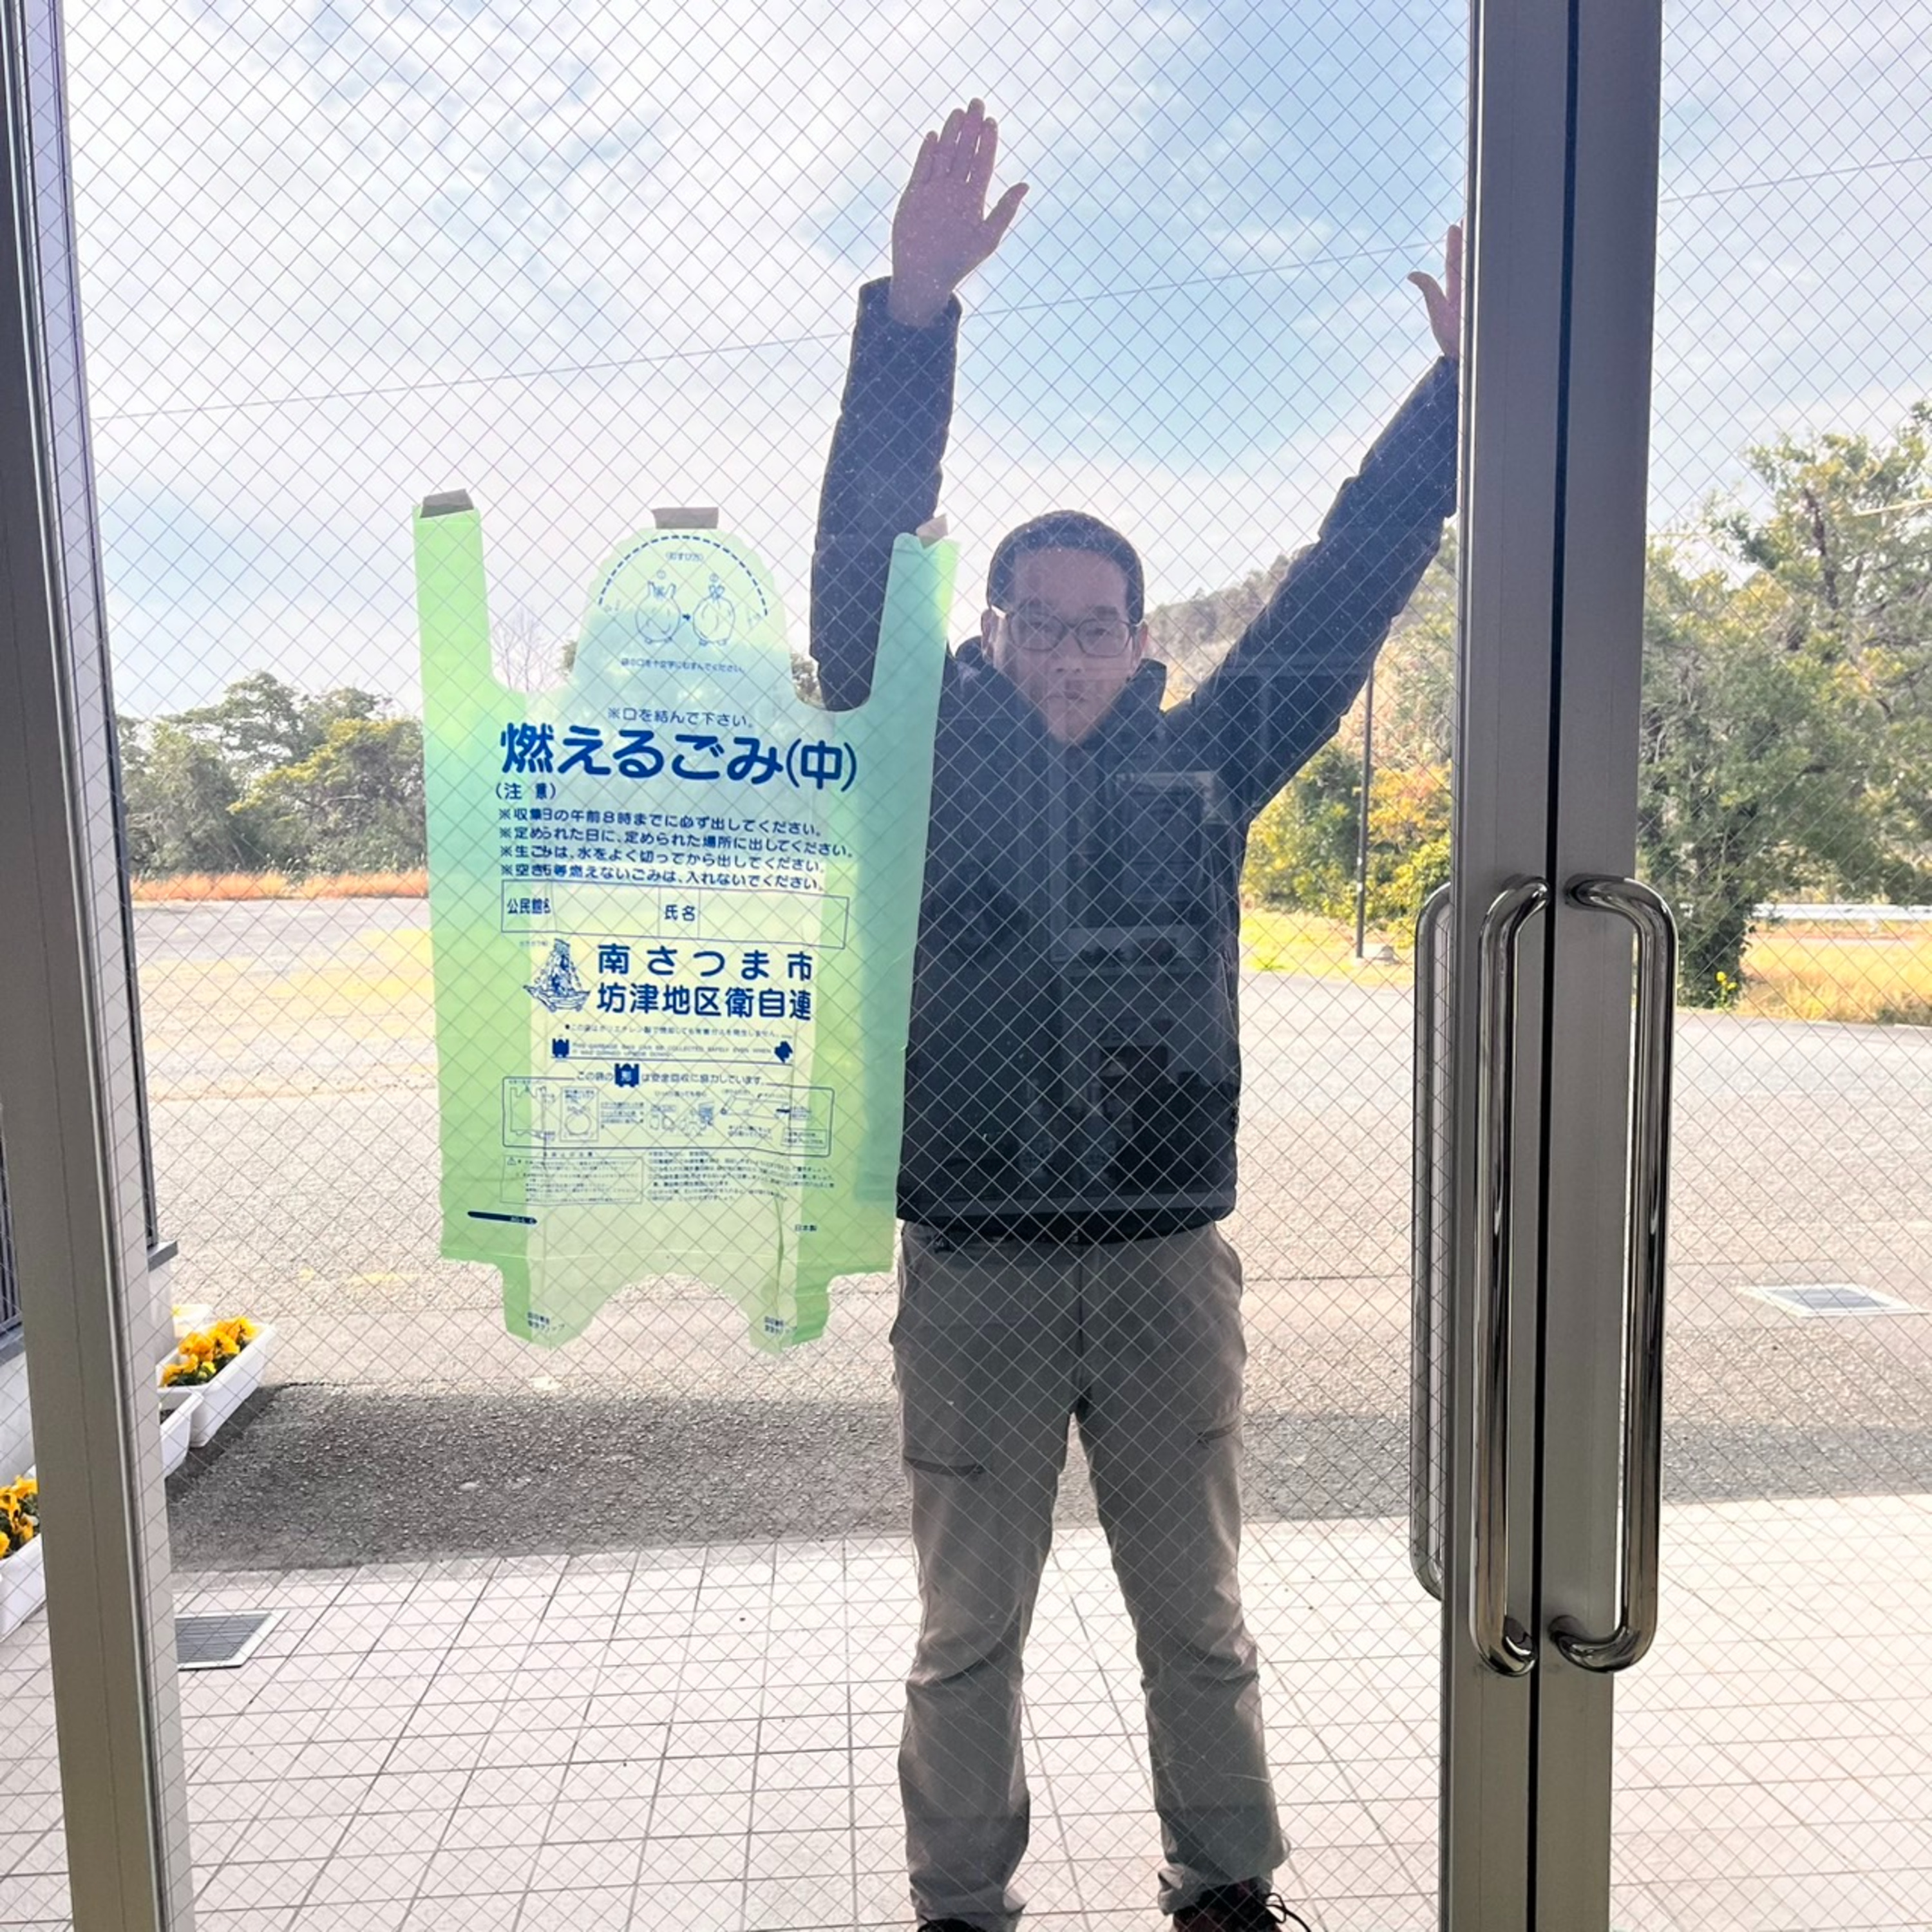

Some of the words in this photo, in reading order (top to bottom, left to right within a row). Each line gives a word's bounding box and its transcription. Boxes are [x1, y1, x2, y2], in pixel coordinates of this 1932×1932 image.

[608, 707, 753, 728] ※口を結んで下さい。
[500, 722, 857, 791] 燃えるごみ(中)
[665, 904, 696, 922] 氏名
[596, 942, 813, 981] 南さつま市
[596, 981, 812, 1021] 坊津地区衛自連
